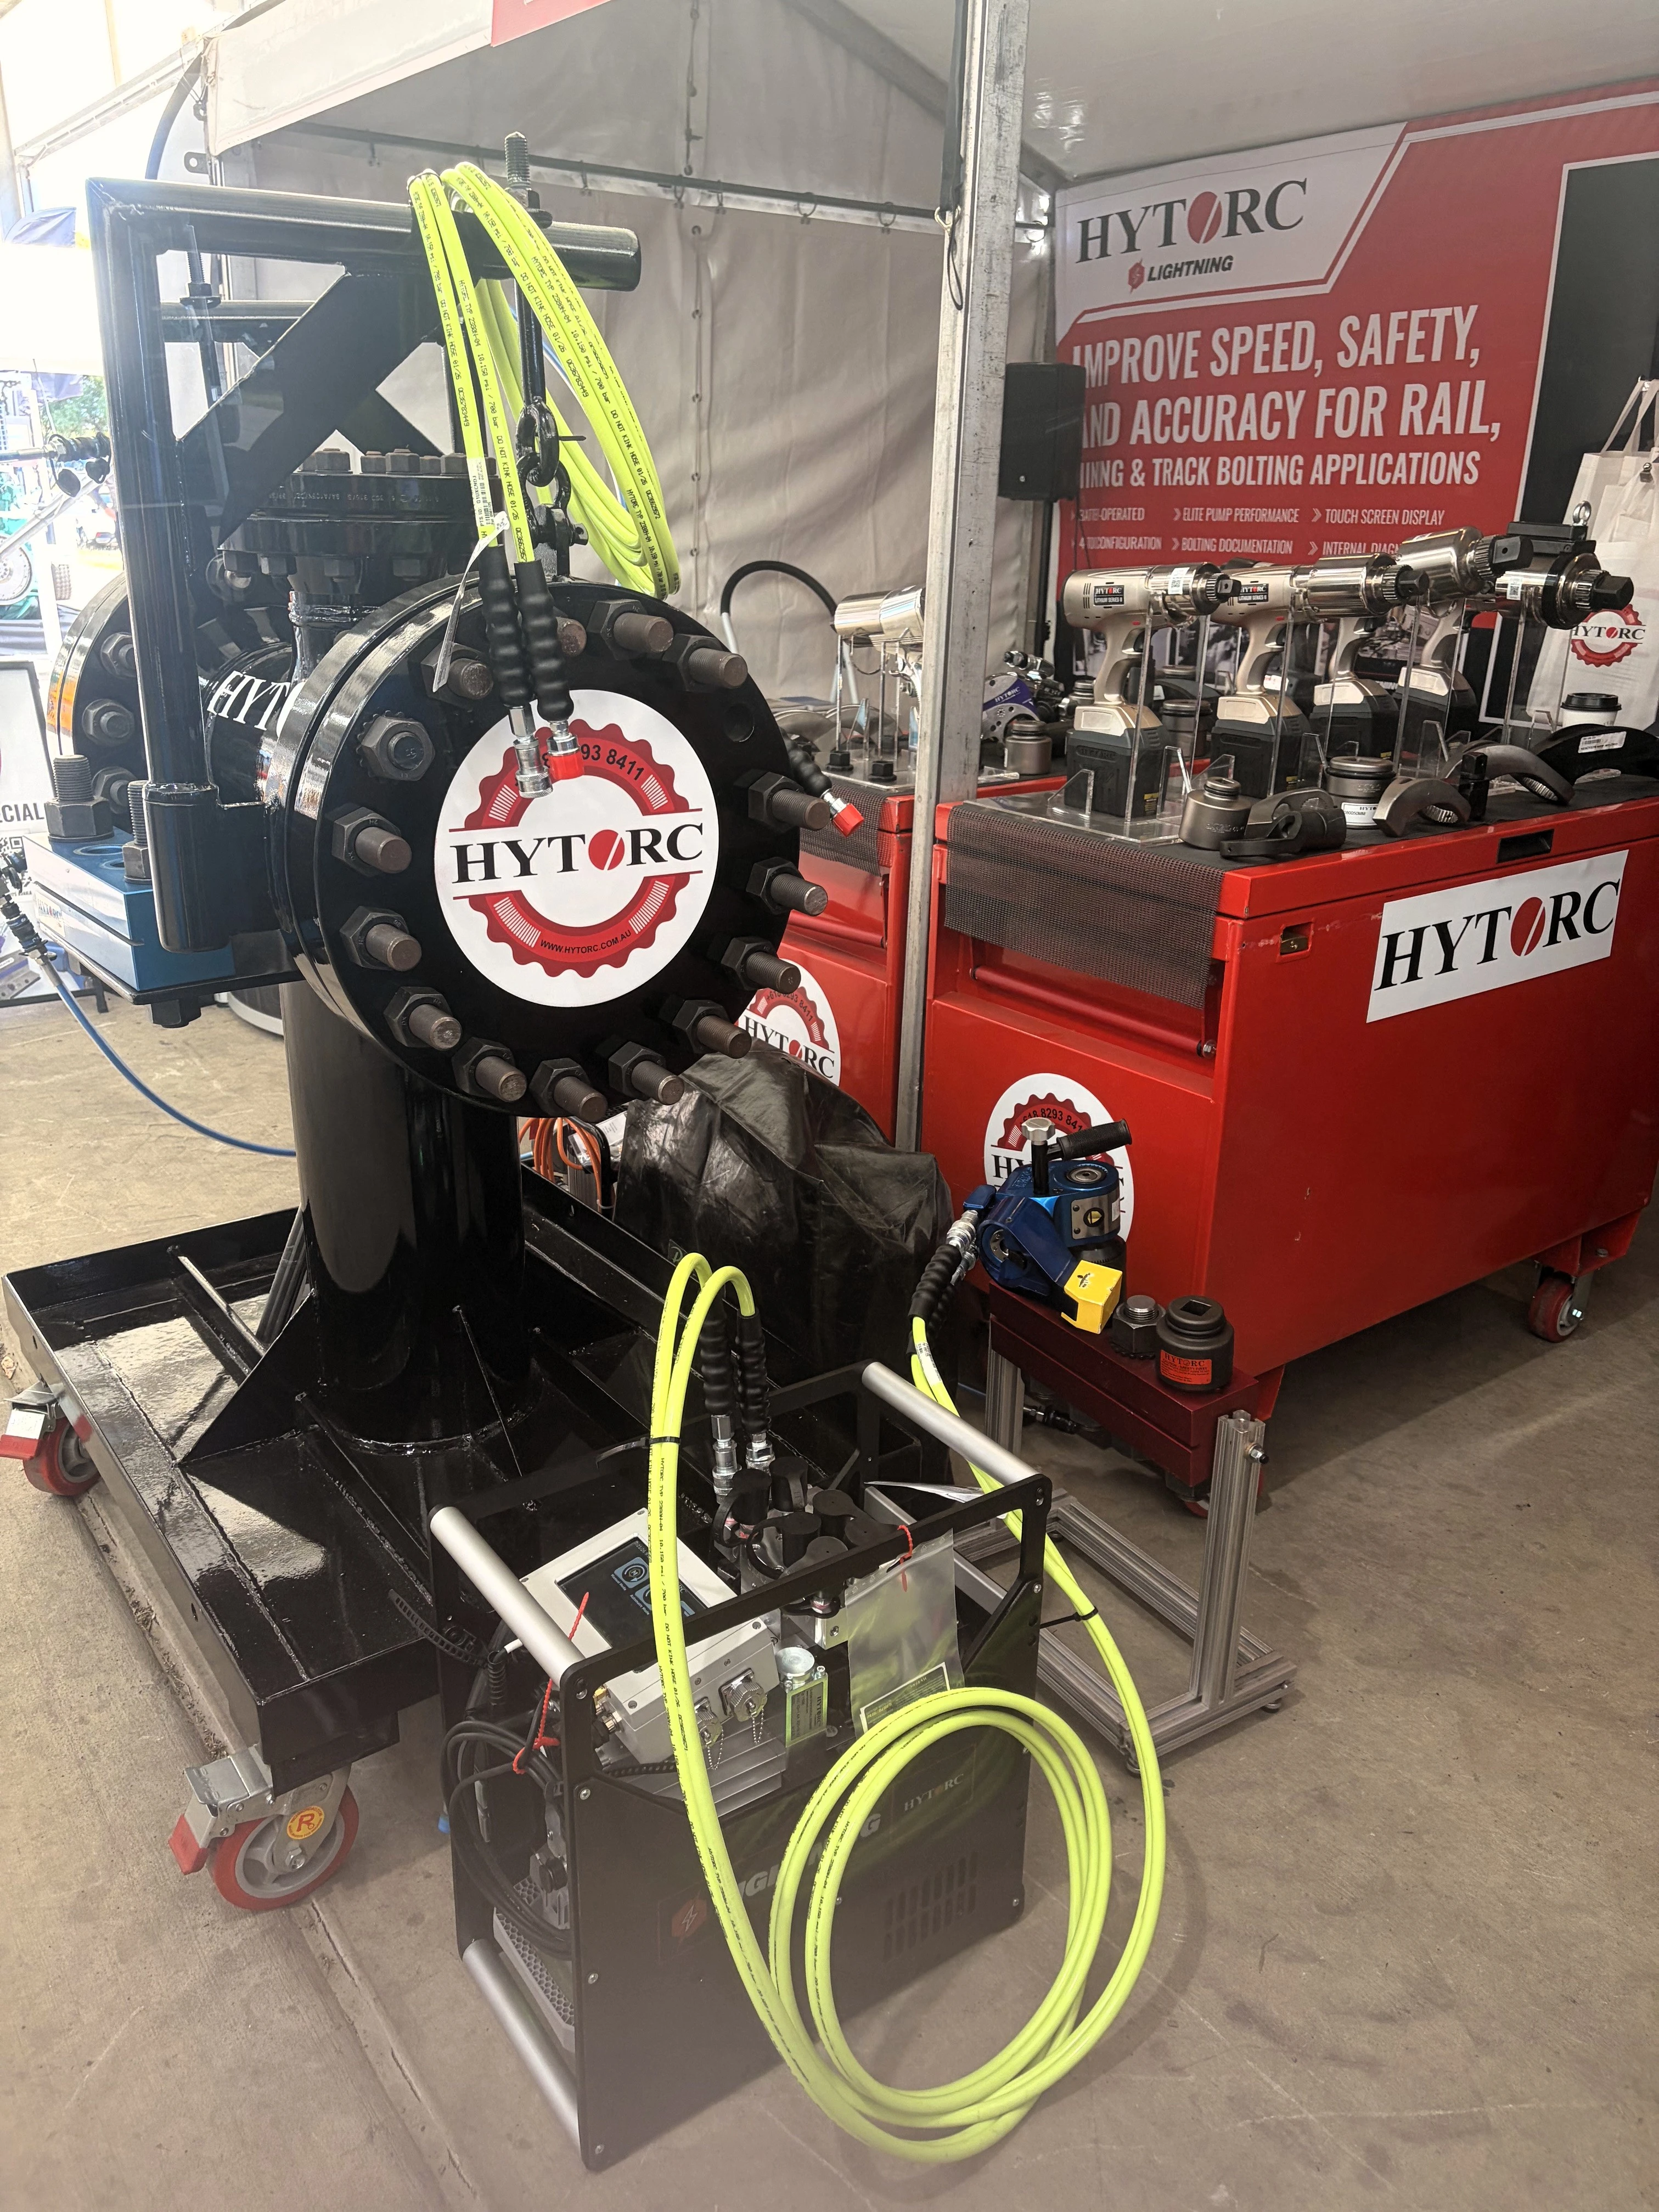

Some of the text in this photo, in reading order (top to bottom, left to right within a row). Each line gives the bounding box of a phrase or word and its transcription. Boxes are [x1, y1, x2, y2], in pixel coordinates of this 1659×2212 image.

[1076, 177, 1307, 263] HYTORC
[1147, 255, 1234, 282] LIGHTNING
[533, 296, 546, 314] KINK
[543, 313, 556, 331] HOSE
[1210, 320, 1323, 378] SPEED,
[1336, 305, 1480, 368] SAFETY,
[544, 279, 555, 291] TYP
[601, 391, 611, 405] bar
[610, 409, 619, 419] DO
[615, 420, 626, 432] NOT
[621, 435, 634, 451] KINK
[629, 451, 640, 467] HOSE
[636, 467, 648, 486] 01/26
[1128, 390, 1306, 445] ACCURACY
[1315, 386, 1387, 438] FOR
[1399, 380, 1501, 442] RAIL,
[1130, 459, 1145, 487] &
[1152, 457, 1211, 486] TRACK
[1216, 454, 1304, 485] BOLTING
[1309, 451, 1481, 485] APPLICATIONS
[506, 481, 515, 498] HOSE
[626, 488, 640, 510] HYTORC
[635, 509, 644, 520] TYP
[1183, 508, 1300, 522] ELITE PUMP PERFORMANCE
[1325, 509, 1445, 525] TOUCH SCREEN DISPLAY
[1218, 538, 1293, 554] DOCUMENTATION
[1323, 541, 1366, 555] INTERNAL
[606, 751, 645, 781] 8411
[0, 802, 45, 823] CIAL
[450, 823, 704, 885] HYTORC
[541, 930, 632, 954] WWW.HYTORC.COM.AU
[1374, 878, 1621, 992] HYTORC
[799, 1000, 814, 1021] 8411
[1041, 1108, 1064, 1121] 8293
[1165, 1353, 1205, 1366] HYTORC
